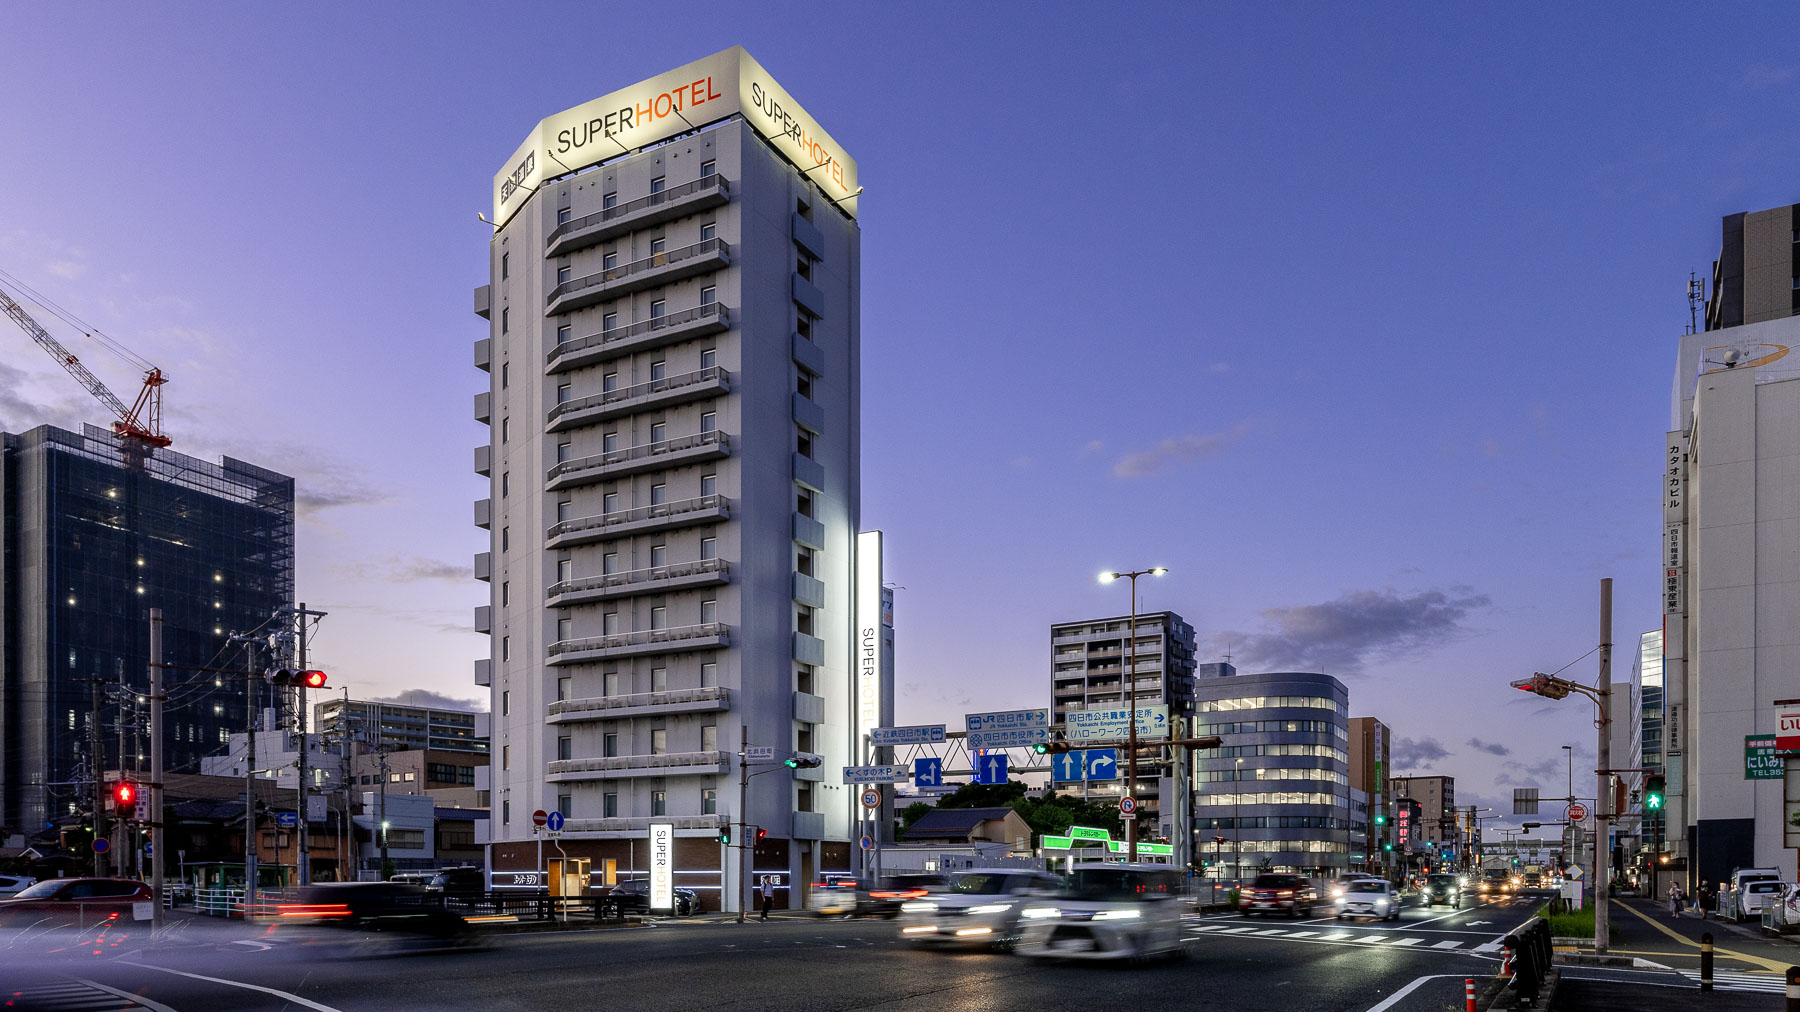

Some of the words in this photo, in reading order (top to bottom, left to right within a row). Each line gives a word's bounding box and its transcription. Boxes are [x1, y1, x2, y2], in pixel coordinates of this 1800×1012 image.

[557, 76, 722, 154] SUPERHOTEL
[751, 81, 848, 192] SUPERHOTEL
[1669, 445, 1680, 508] カタオカビル
[862, 627, 875, 727] SUPERHOTEL
[882, 727, 930, 739] 近鉄四日市駅
[983, 712, 1034, 723] JR四日市駅
[983, 730, 1035, 742] 四日市市役所
[1100, 719, 1129, 727] Employment
[864, 794, 877, 804] 50
[656, 829, 667, 903] SUPERHOTEL
